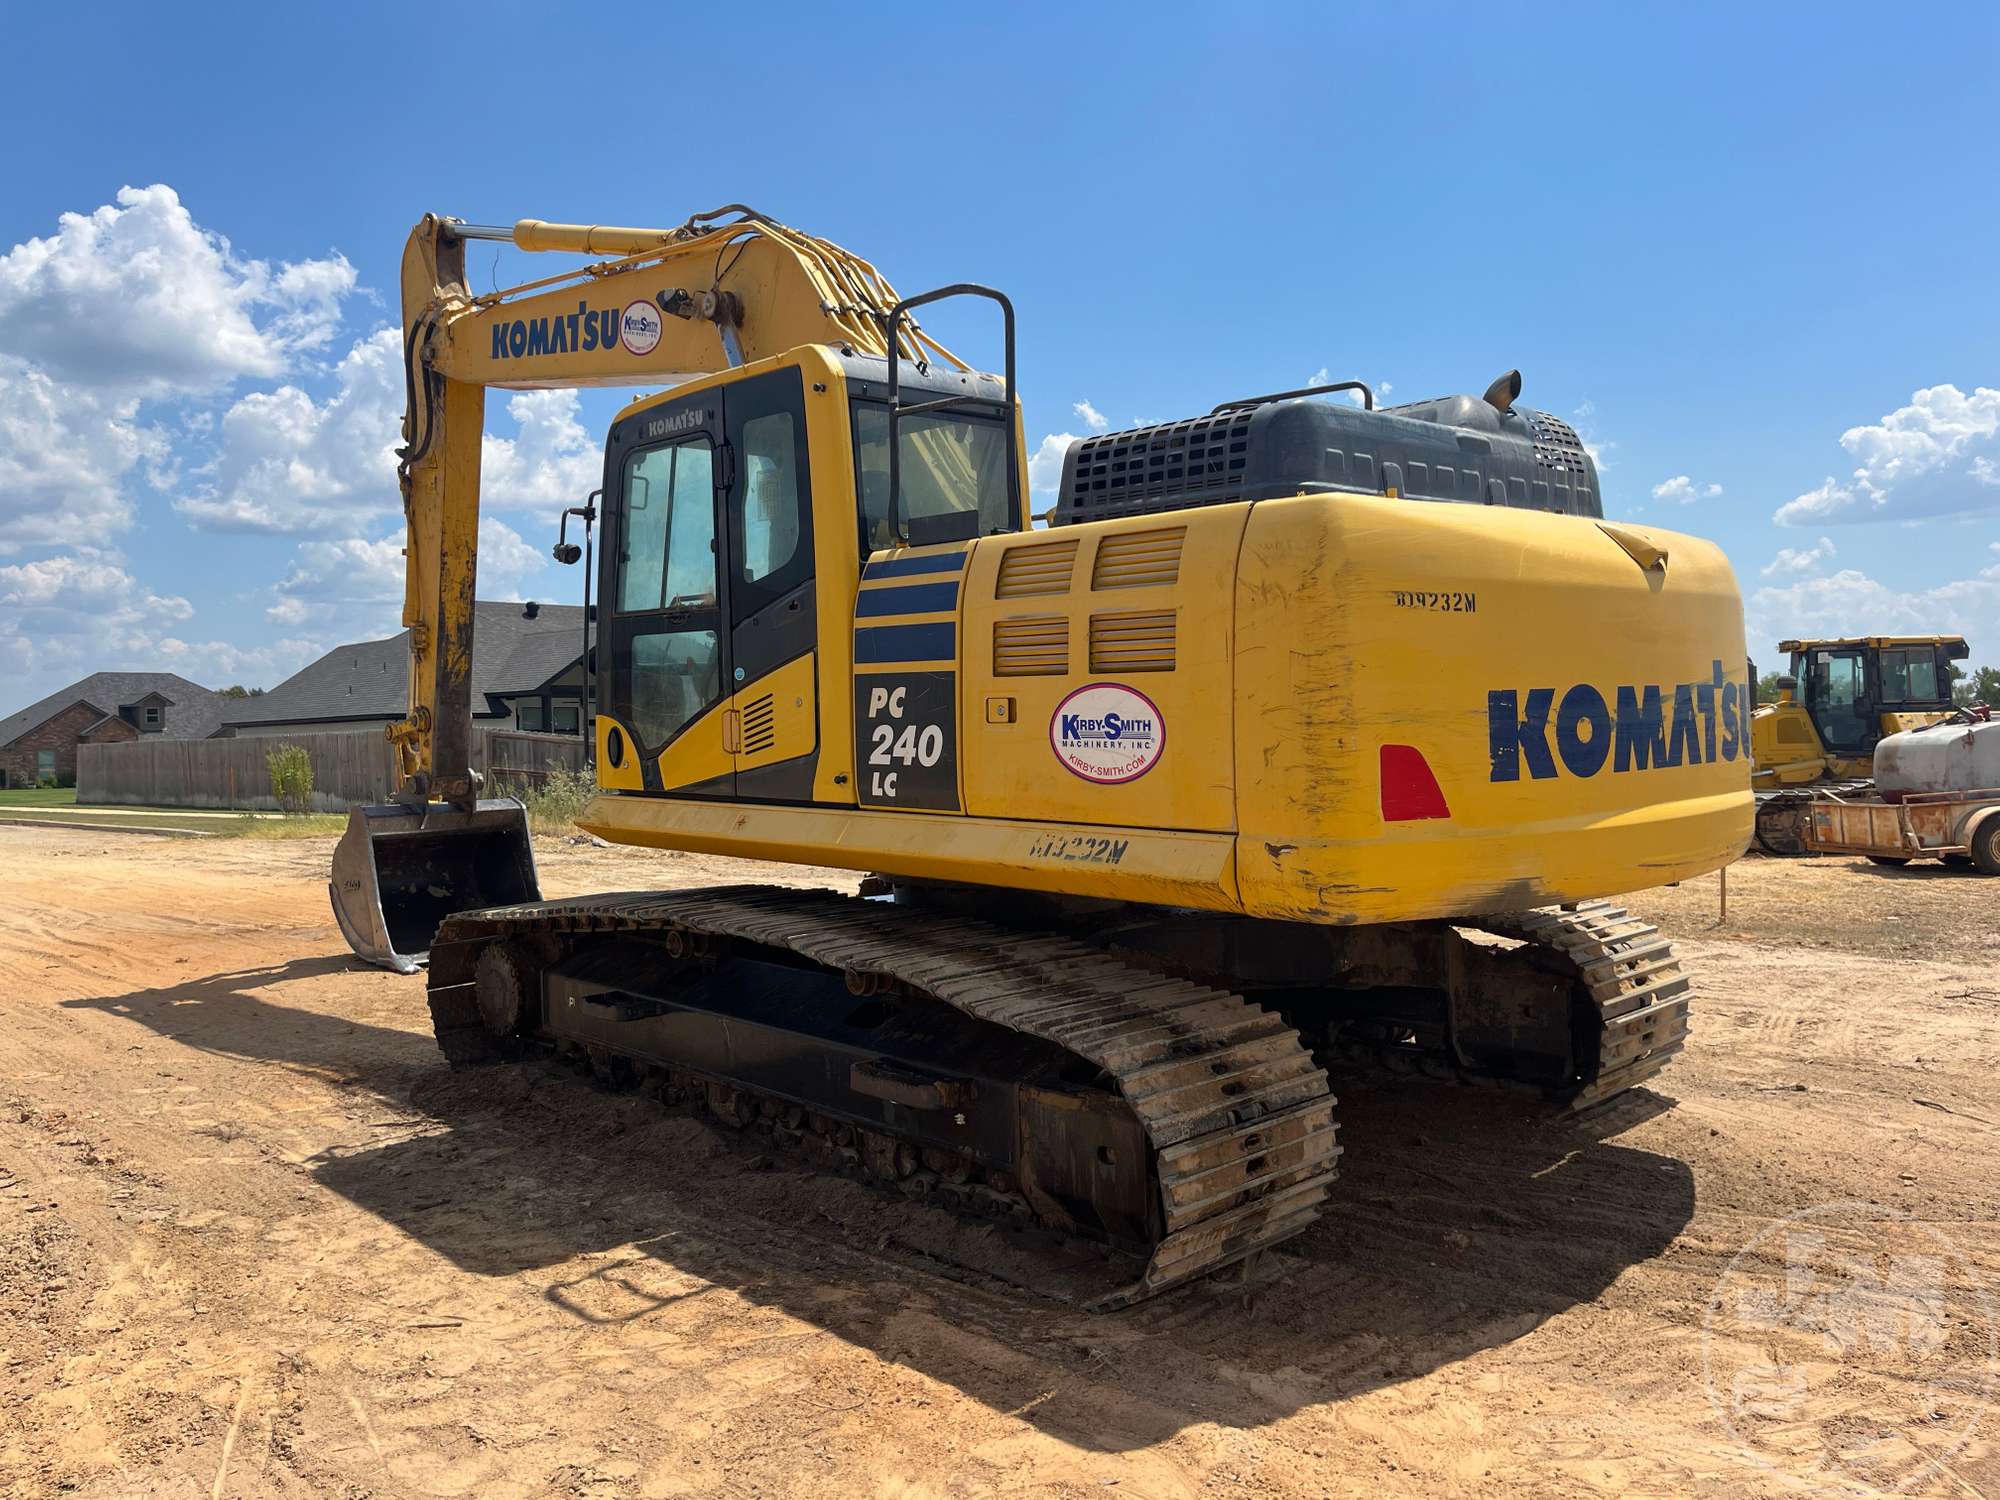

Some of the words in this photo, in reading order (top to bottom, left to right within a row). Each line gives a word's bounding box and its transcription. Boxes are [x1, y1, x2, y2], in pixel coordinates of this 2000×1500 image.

[492, 301, 619, 359] KOMATSU
[649, 408, 703, 437] KOMATSU
[869, 687, 906, 718] PC
[1062, 713, 1151, 740] KIRBY-SMITH
[868, 724, 943, 767] 240
[1062, 740, 1126, 750] MACHINERY,
[1069, 753, 1146, 777] KIRBY-SMITH.COM
[871, 772, 897, 797] LC
